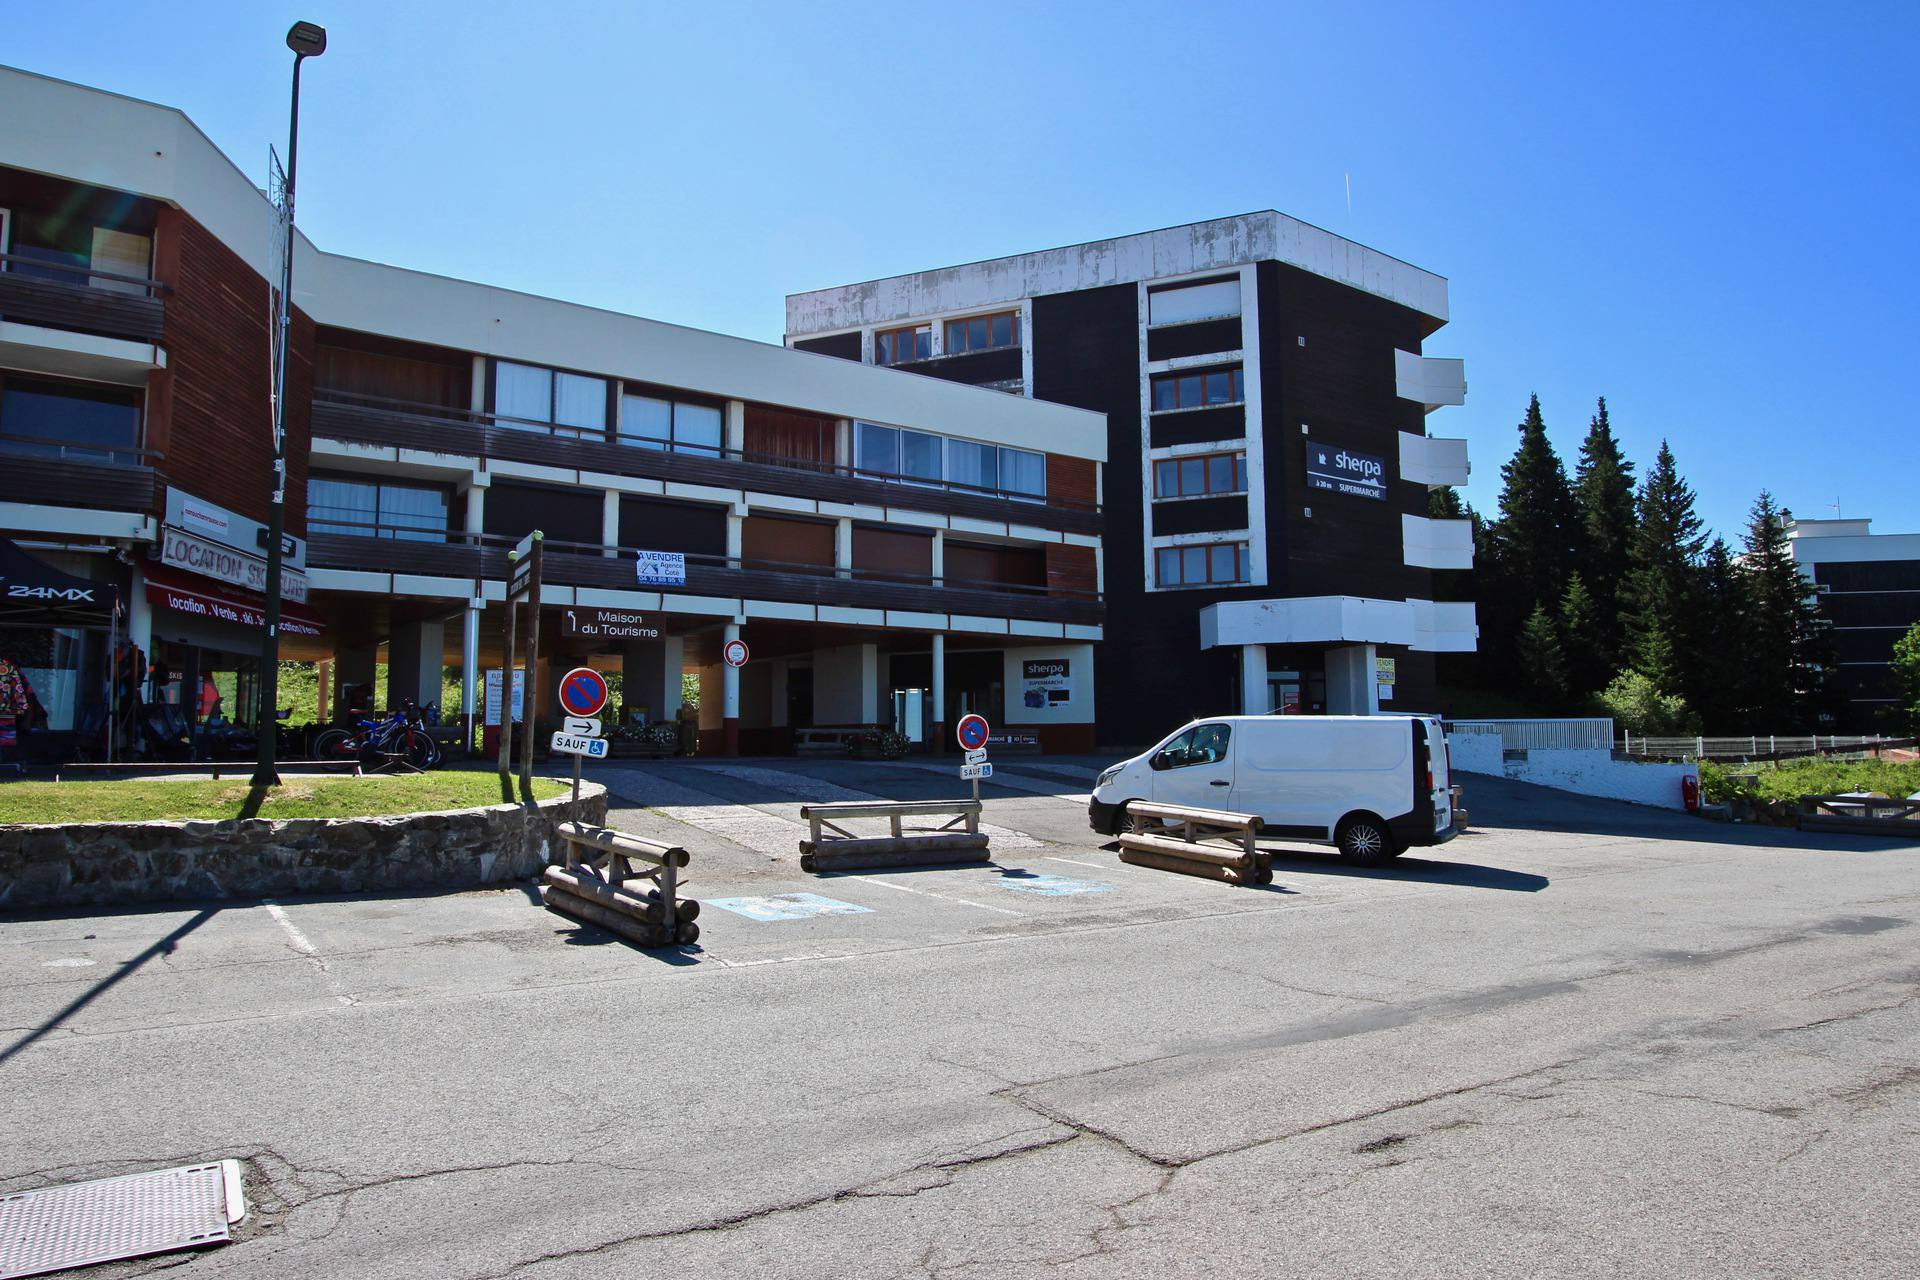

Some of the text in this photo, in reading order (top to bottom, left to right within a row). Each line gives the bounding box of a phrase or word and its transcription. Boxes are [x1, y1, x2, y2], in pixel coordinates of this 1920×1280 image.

[1335, 451, 1381, 477] sherpa
[164, 537, 243, 579] LOCATION
[645, 552, 683, 562] VENDRE
[8, 585, 95, 602] 24MX
[168, 593, 206, 615] Location
[211, 603, 238, 621] Vente
[597, 611, 642, 624] Maison
[581, 623, 658, 638] du Tourisme
[1028, 664, 1064, 675] sherpa
[556, 737, 587, 750] SAUF
[964, 767, 981, 777] SAUF
